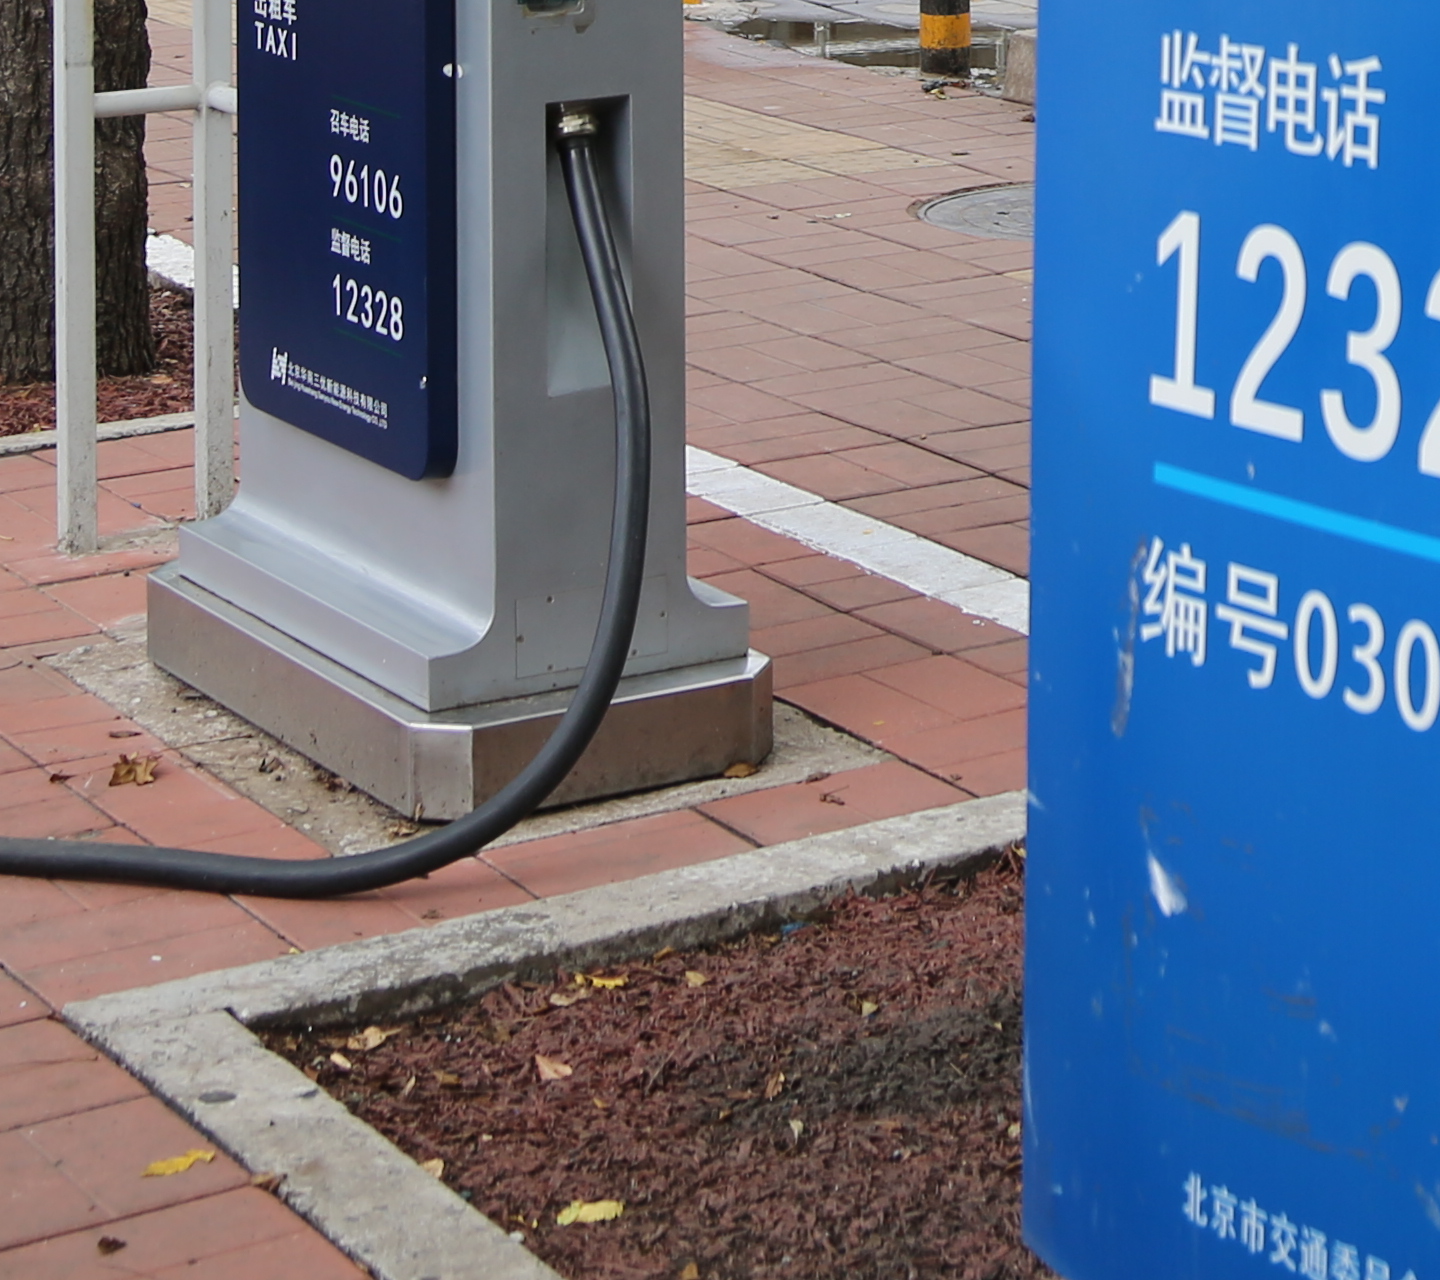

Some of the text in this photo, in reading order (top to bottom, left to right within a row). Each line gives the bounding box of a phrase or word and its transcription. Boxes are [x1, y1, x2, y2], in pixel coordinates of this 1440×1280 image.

[254, 20, 298, 61] TAXI
[329, 108, 371, 144] 召车电话
[1154, 29, 1387, 169] 监督电话
[328, 153, 404, 220] 96106
[330, 227, 372, 266] 监督电话
[332, 273, 405, 342] 12328
